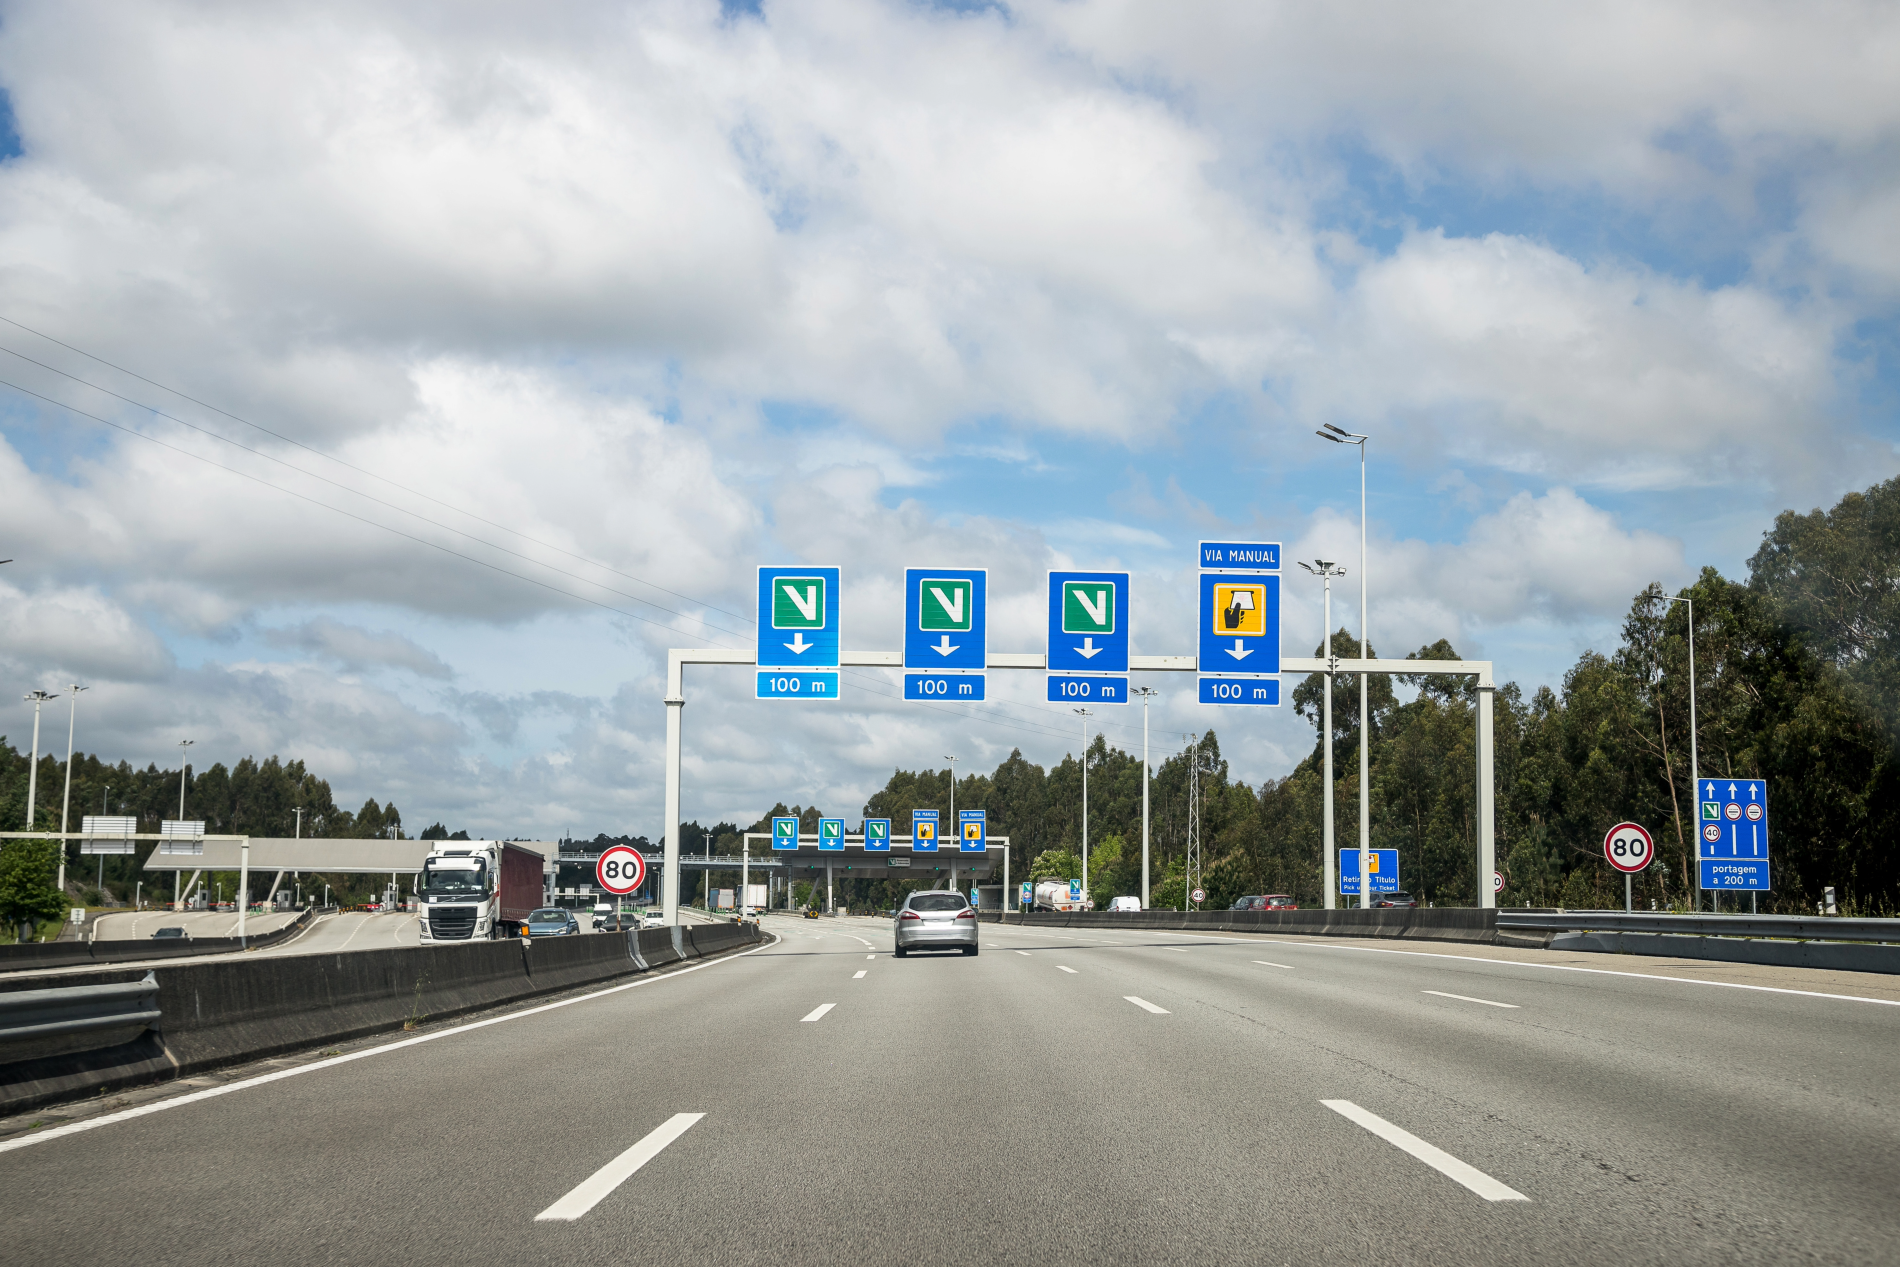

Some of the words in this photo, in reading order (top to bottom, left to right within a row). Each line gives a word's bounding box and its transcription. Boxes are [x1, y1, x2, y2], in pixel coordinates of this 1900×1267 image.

[1205, 550, 1222, 562] VIA
[1229, 550, 1276, 562] MANUAL
[770, 678, 800, 692] 100
[812, 681, 826, 692] m
[917, 680, 948, 694] 100
[958, 684, 972, 694] m
[1060, 682, 1090, 696] 100
[1102, 686, 1115, 697] m
[1212, 684, 1242, 699] 100
[1253, 688, 1267, 699] m
[1614, 838, 1644, 857] 80
[606, 860, 636, 880] 80
[1712, 865, 1756, 874] portagem
[1495, 878, 1500, 886] 0
[1724, 876, 1744, 884] 200
